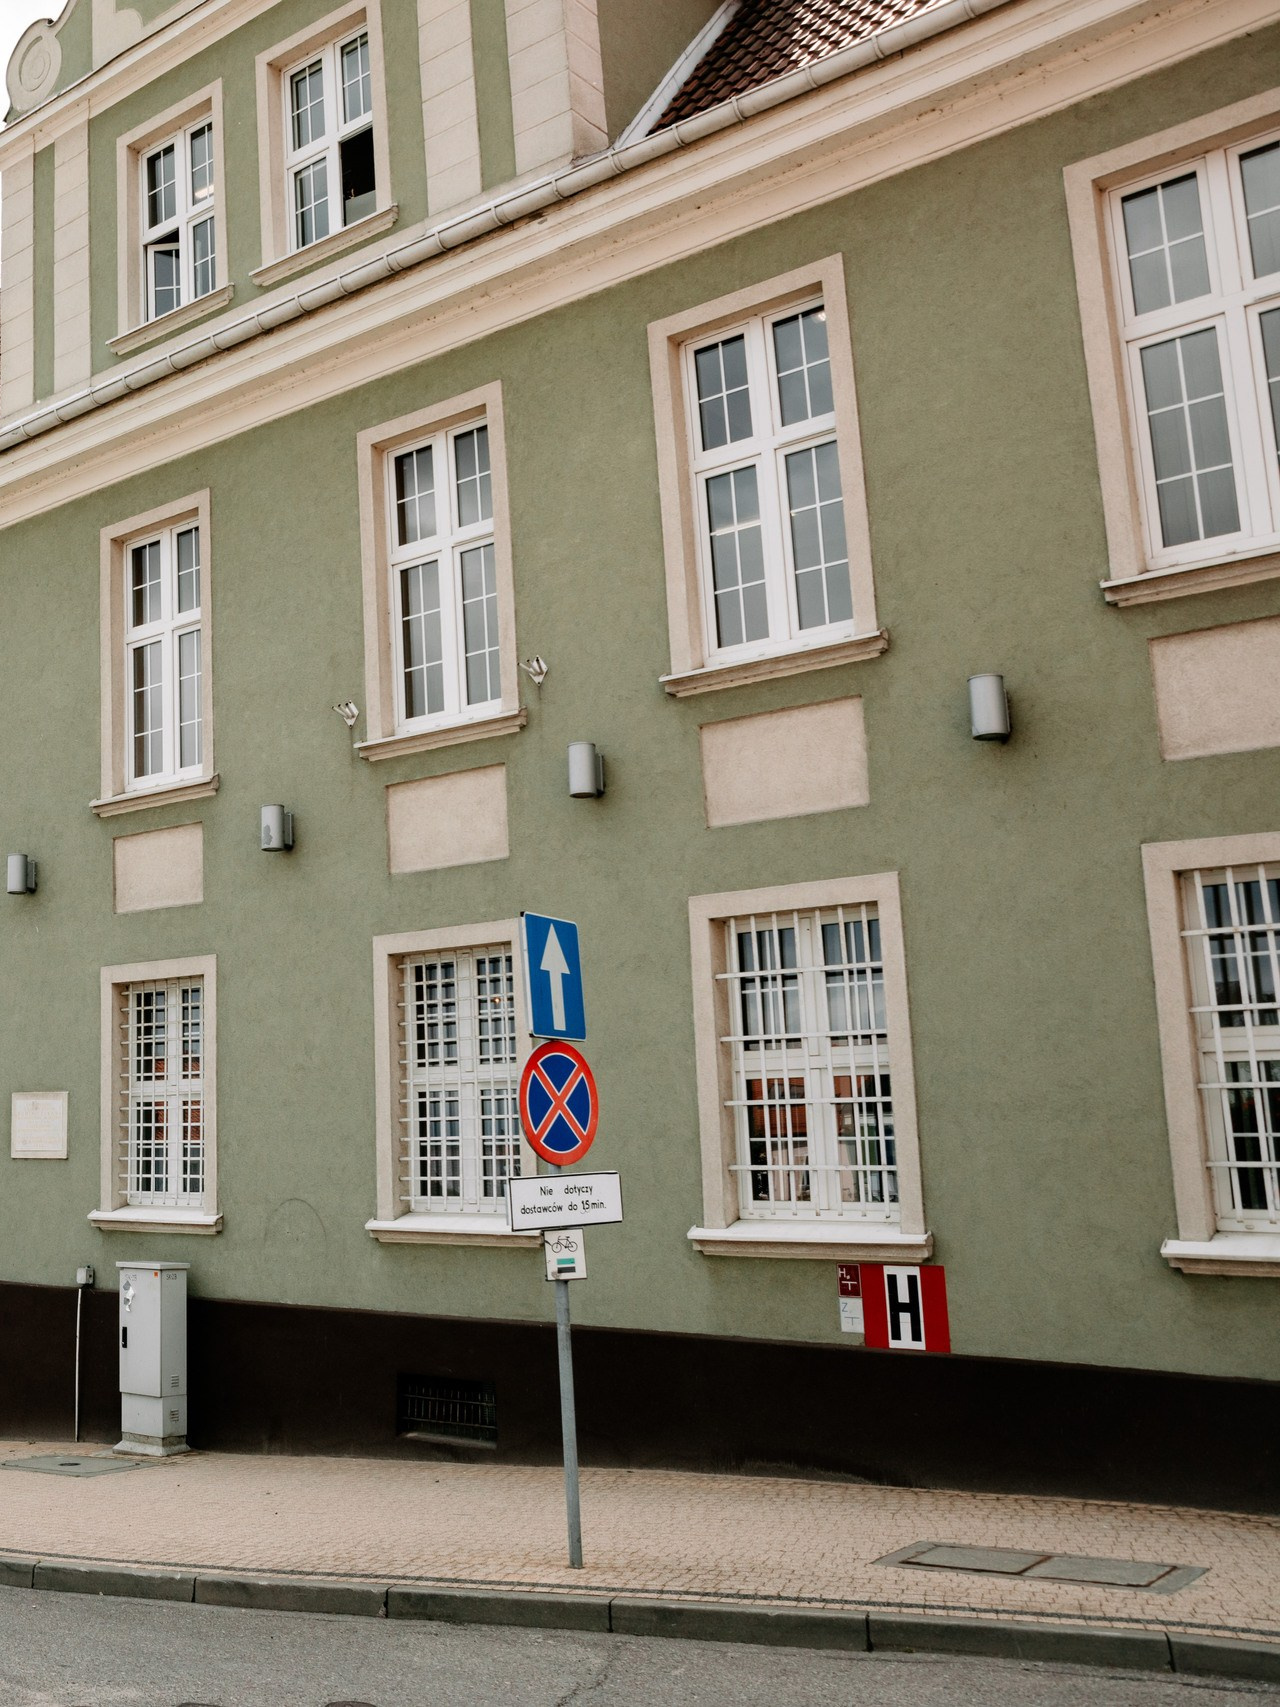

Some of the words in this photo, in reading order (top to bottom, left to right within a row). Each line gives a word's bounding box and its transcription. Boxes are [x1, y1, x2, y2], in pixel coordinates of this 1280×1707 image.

[540, 1186, 553, 1195] Nie
[564, 1184, 593, 1196] dotyczy
[521, 1203, 563, 1214] dostawców
[568, 1201, 578, 1211] do
[886, 1274, 923, 1342] H
